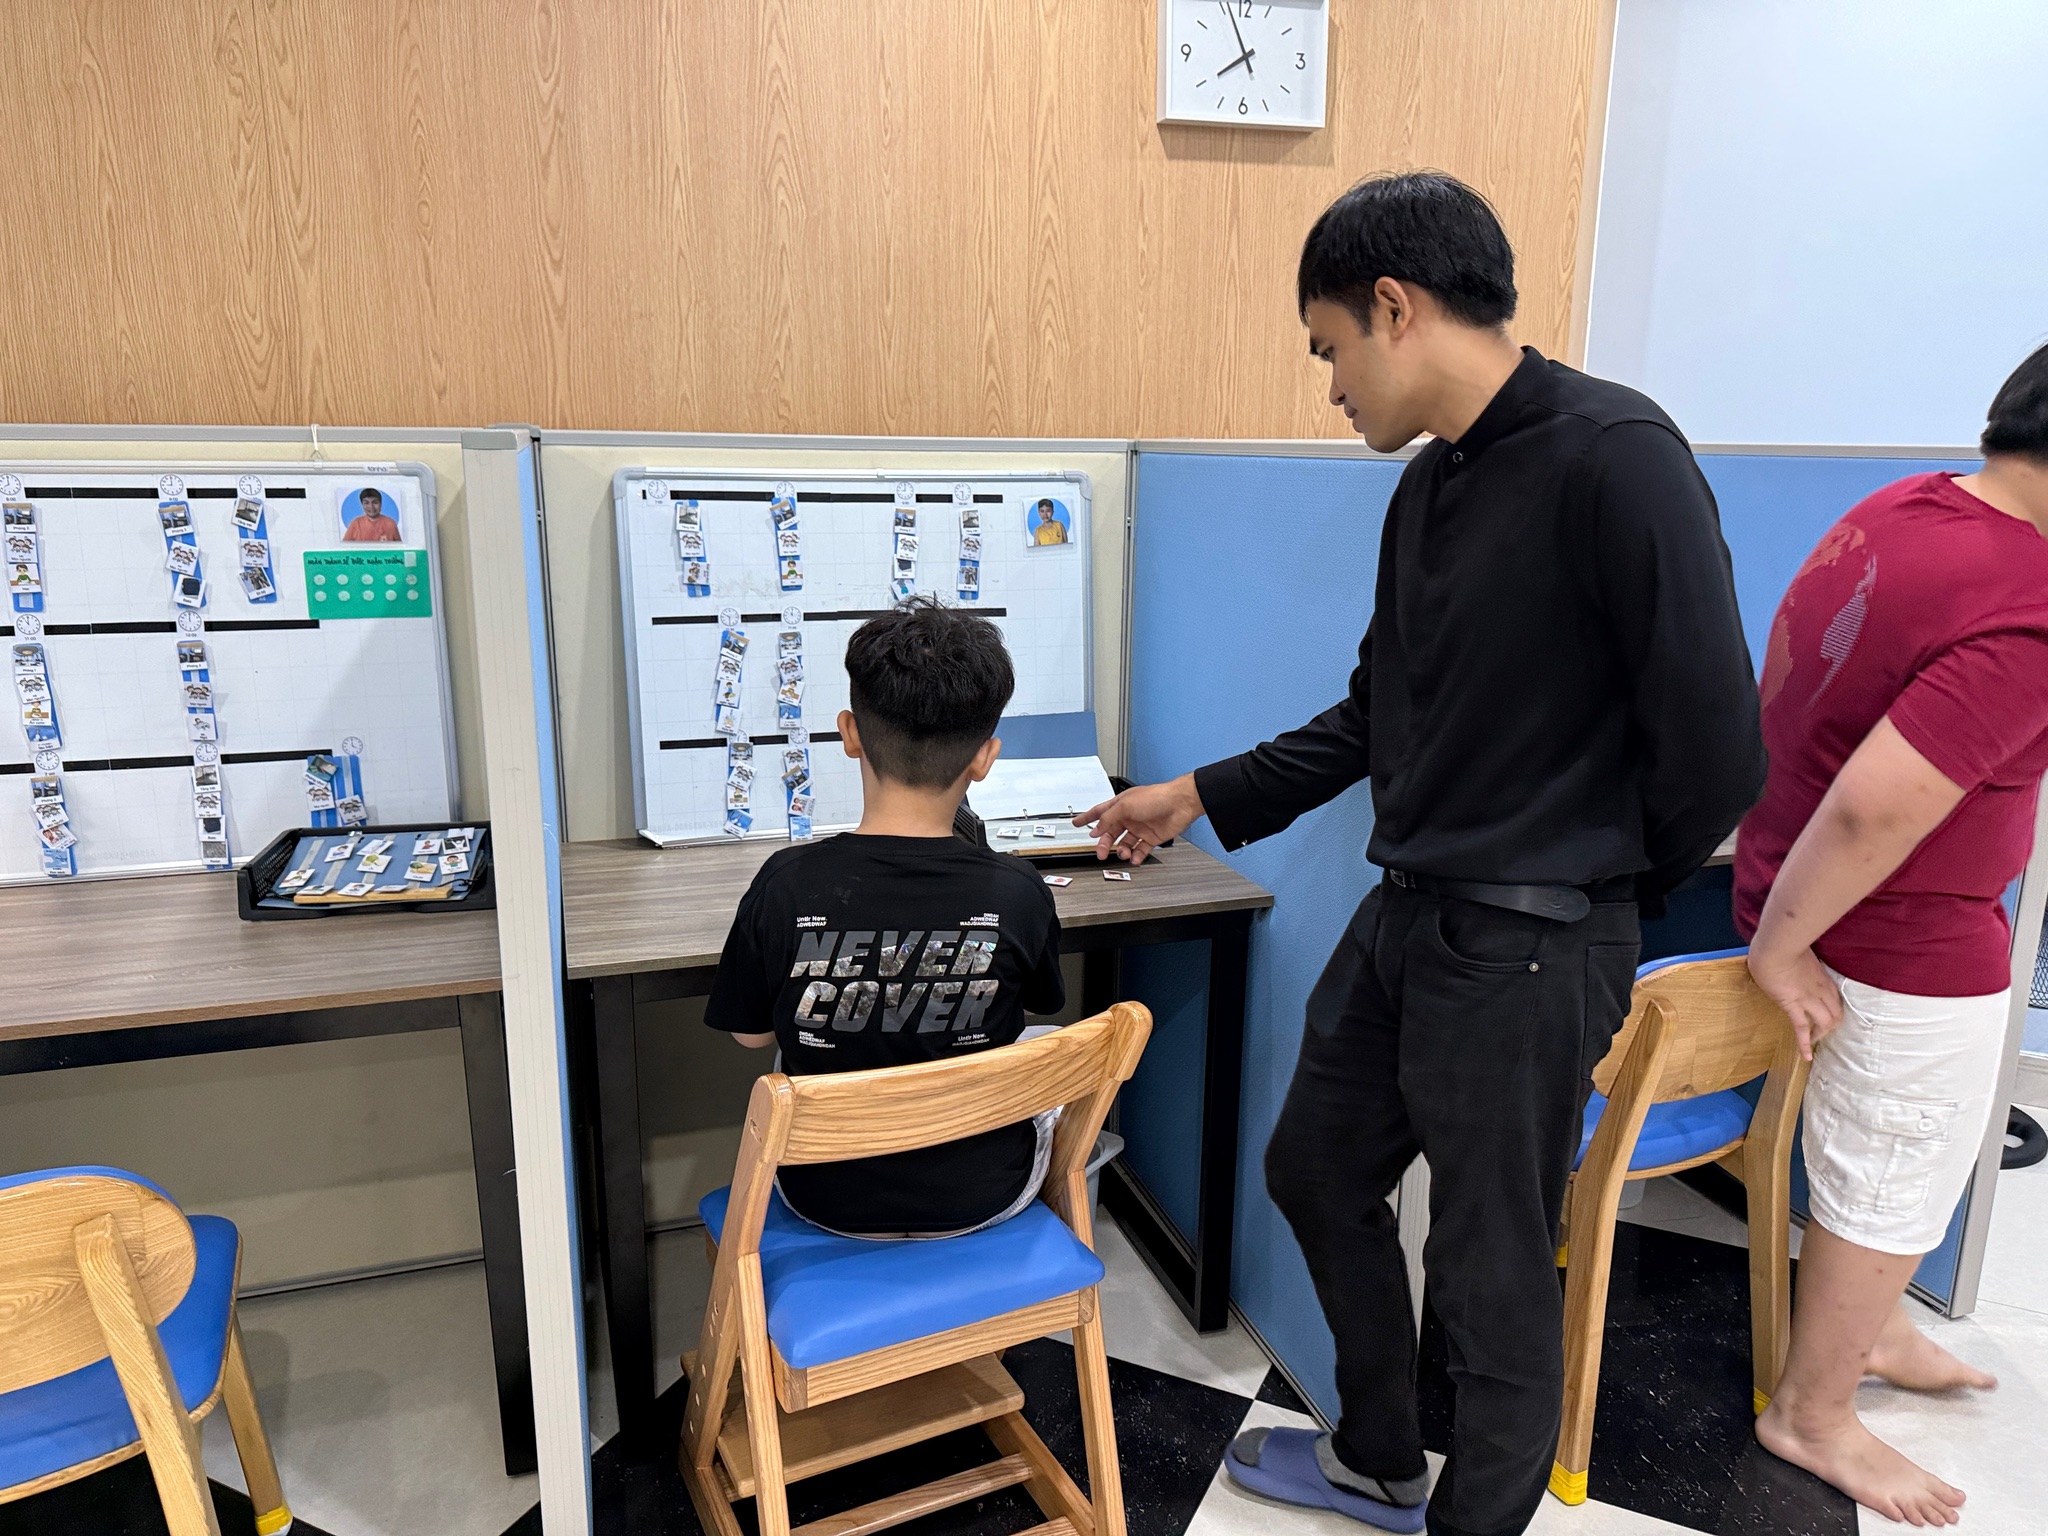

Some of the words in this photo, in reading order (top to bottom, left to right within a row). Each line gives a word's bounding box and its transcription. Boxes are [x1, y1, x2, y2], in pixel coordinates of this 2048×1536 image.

[1238, 0, 1252, 19] 12
[1180, 43, 1192, 62] 9
[1295, 53, 1306, 70] 3
[1238, 97, 1249, 115] 6
[790, 930, 1000, 978] NEVER
[794, 979, 1000, 1034] COVER
